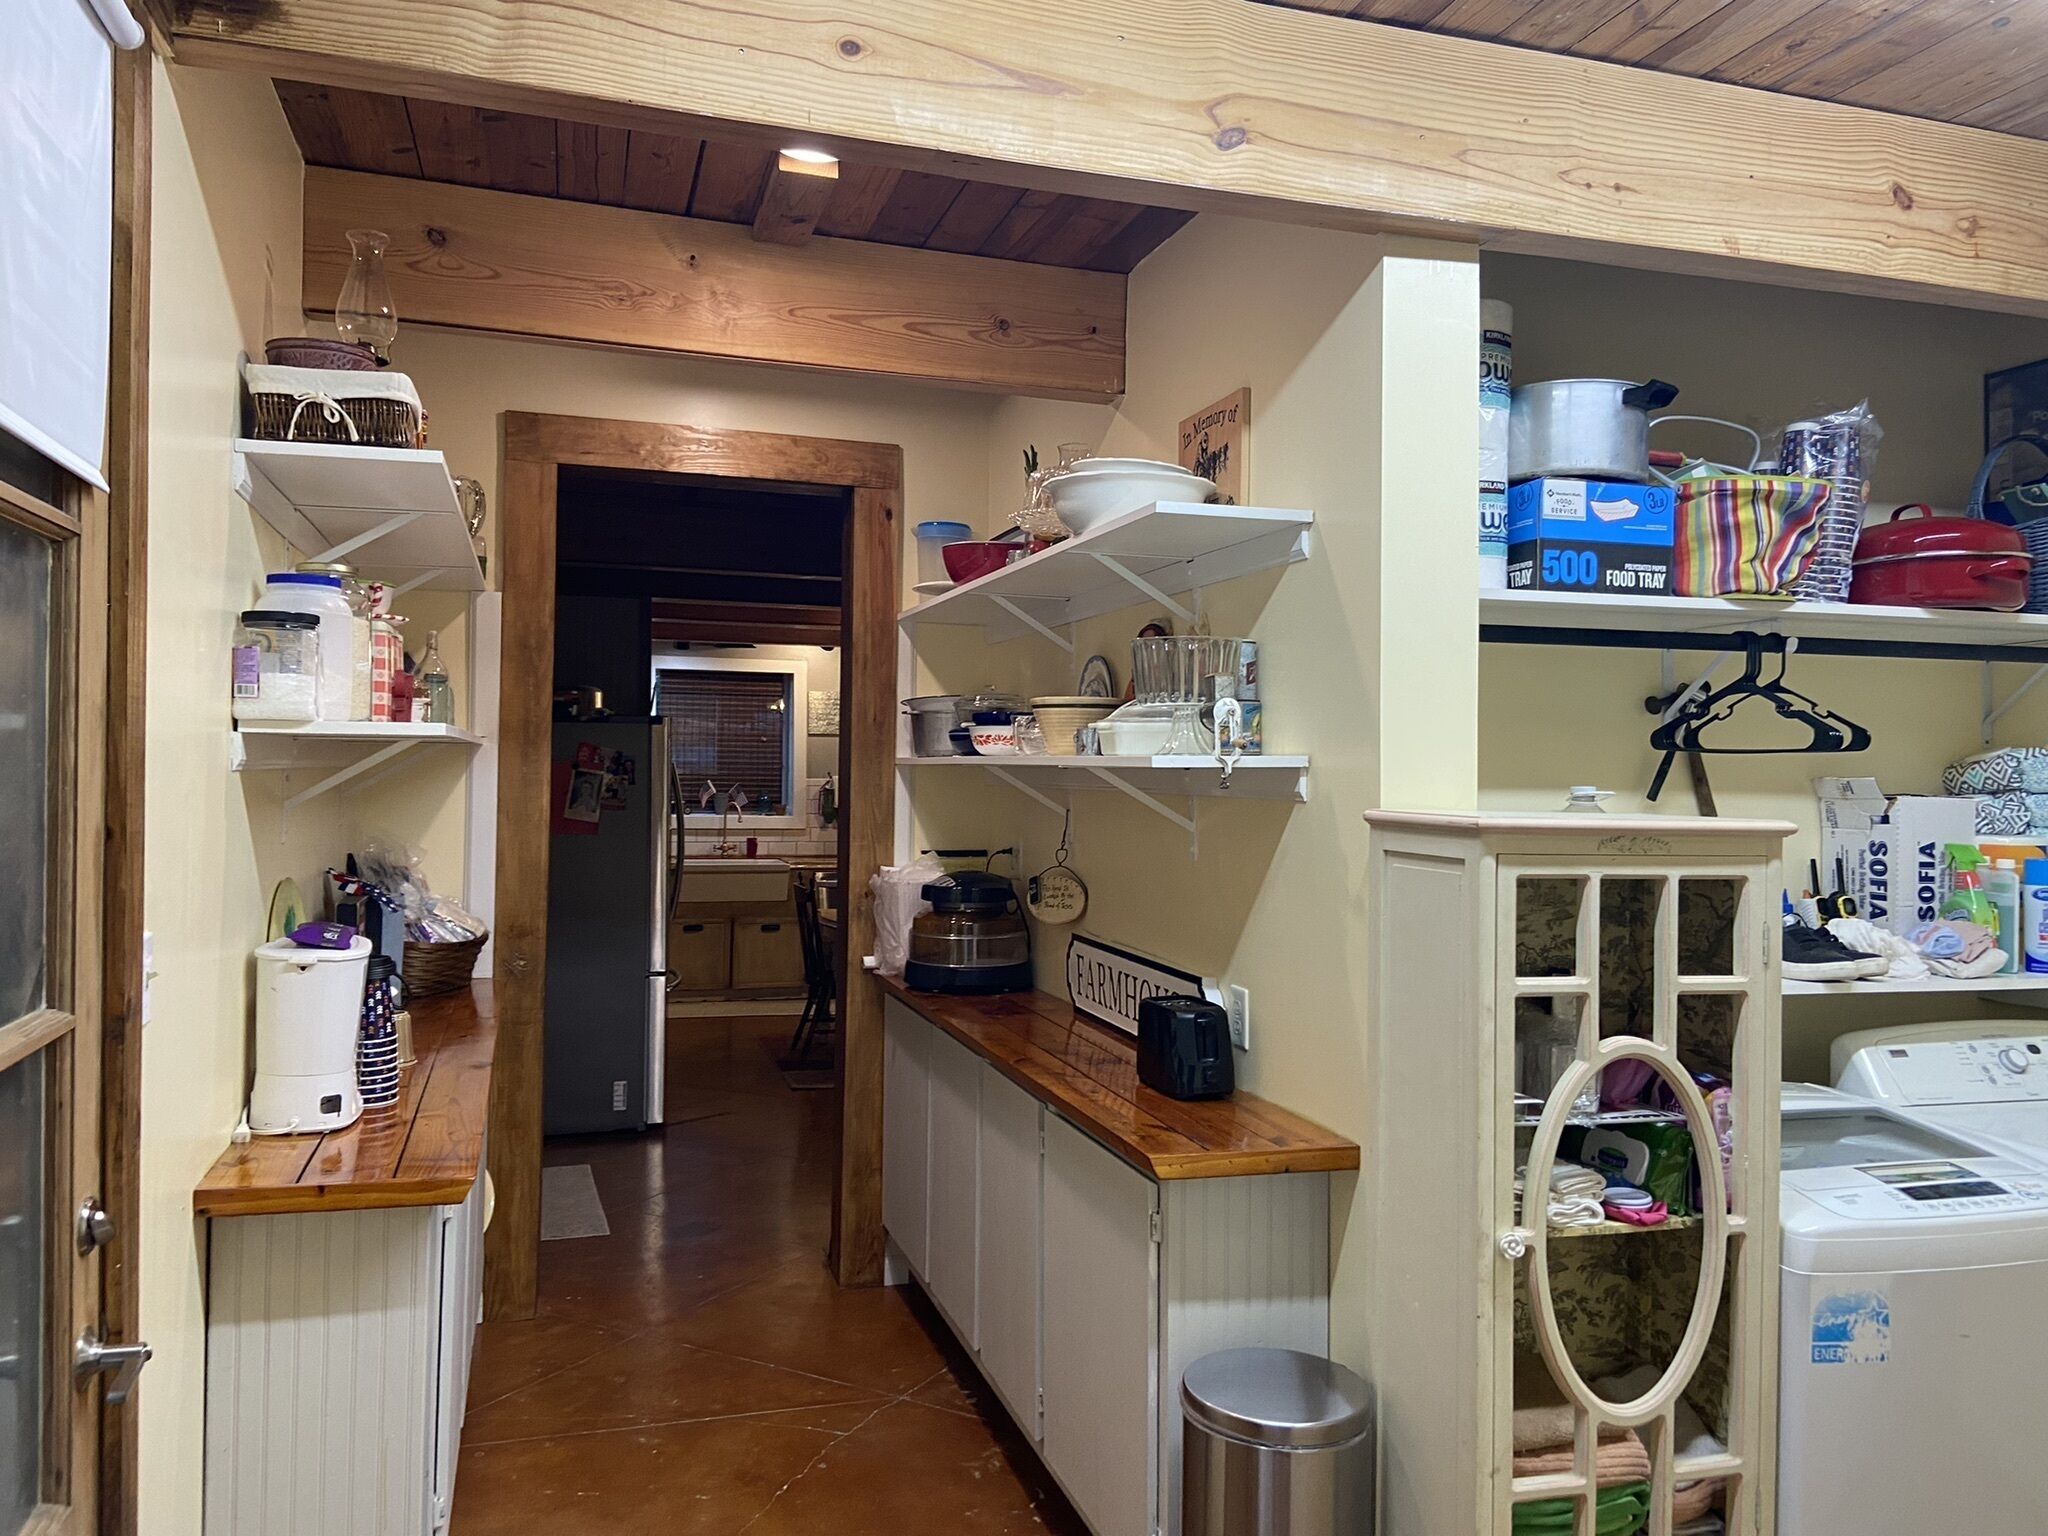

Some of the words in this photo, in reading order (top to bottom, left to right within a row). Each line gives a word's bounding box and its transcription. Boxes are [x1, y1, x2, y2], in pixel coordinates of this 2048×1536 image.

[1183, 433, 1192, 450] In
[1192, 410, 1227, 439] Memory
[1228, 404, 1239, 423] of
[1551, 507, 1578, 516] SERVICE
[1509, 568, 1533, 588] TRAY
[1542, 549, 1598, 585] 500
[1606, 569, 1635, 587] FOOD
[1637, 571, 1666, 590] TRAY
[1868, 840, 1889, 920] SOFIA
[1917, 842, 1936, 923] SOFIA
